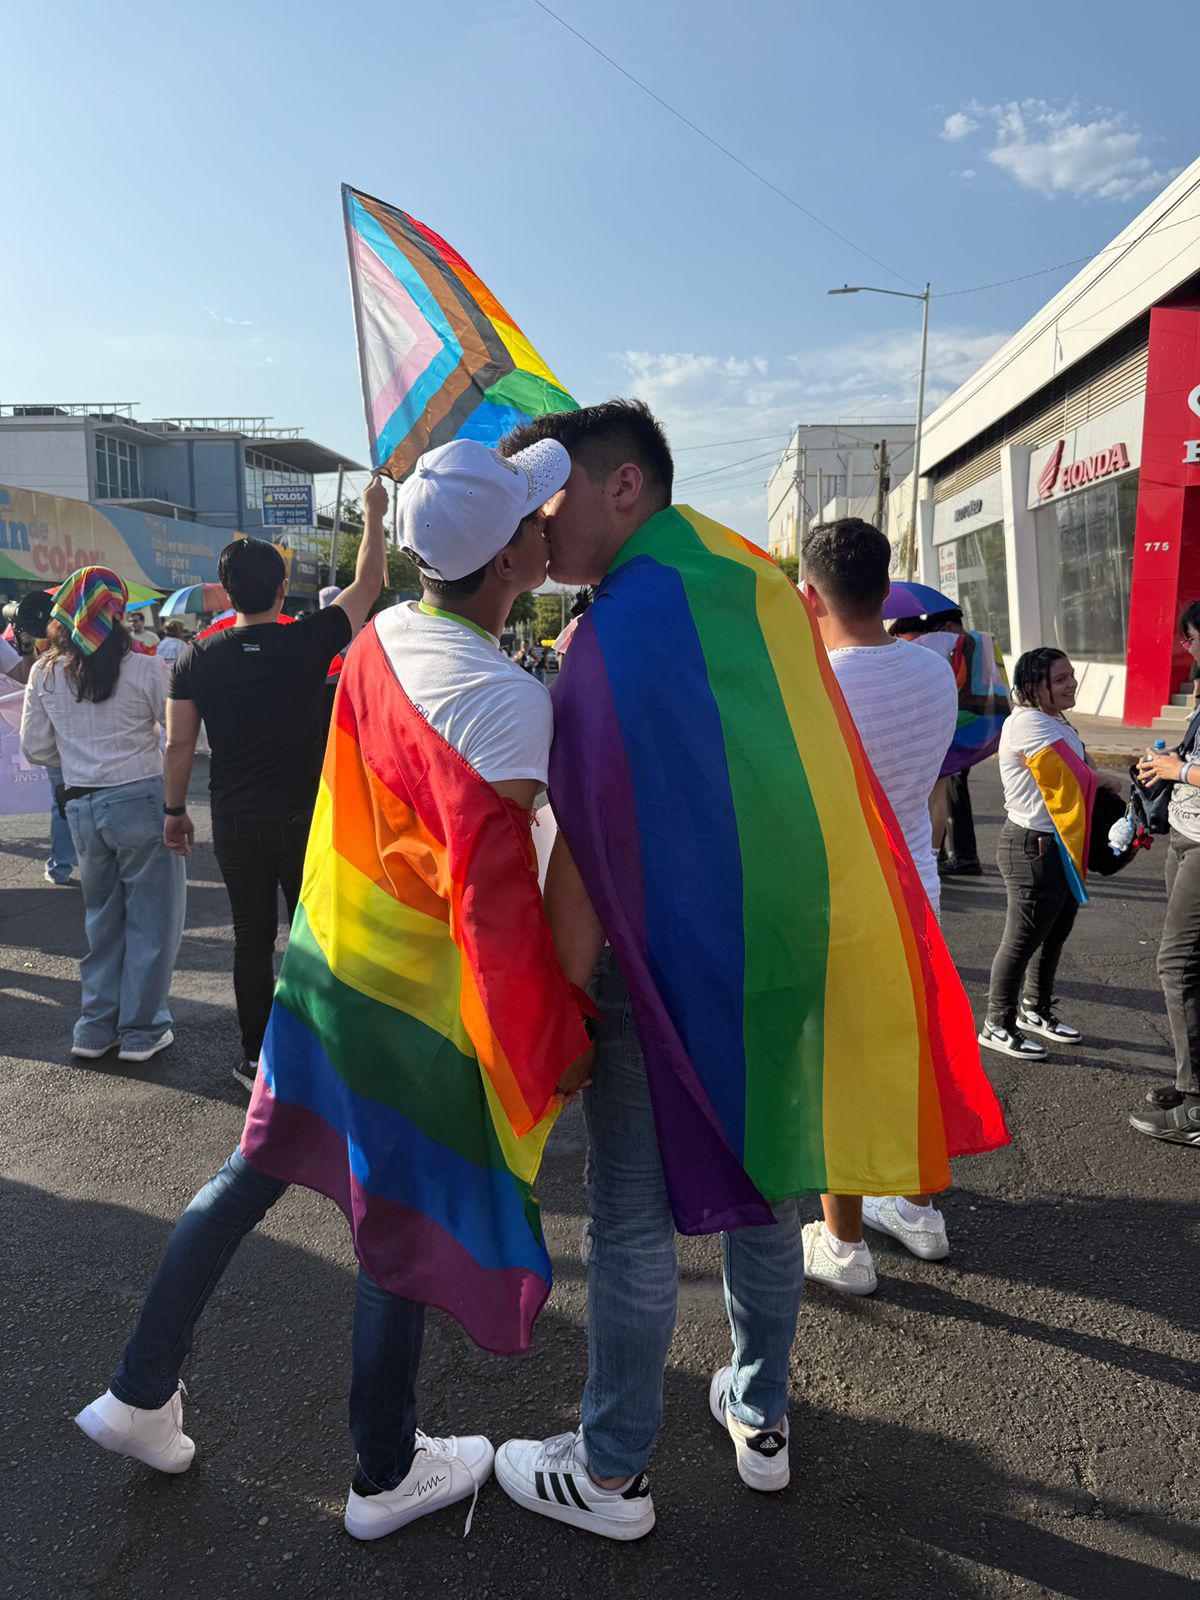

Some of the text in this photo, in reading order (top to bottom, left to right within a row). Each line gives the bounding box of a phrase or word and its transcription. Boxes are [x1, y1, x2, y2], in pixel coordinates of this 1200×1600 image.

[1059, 442, 1131, 492] HONDA
[273, 493, 308, 501] TOLOSA
[1144, 542, 1170, 552] 775
